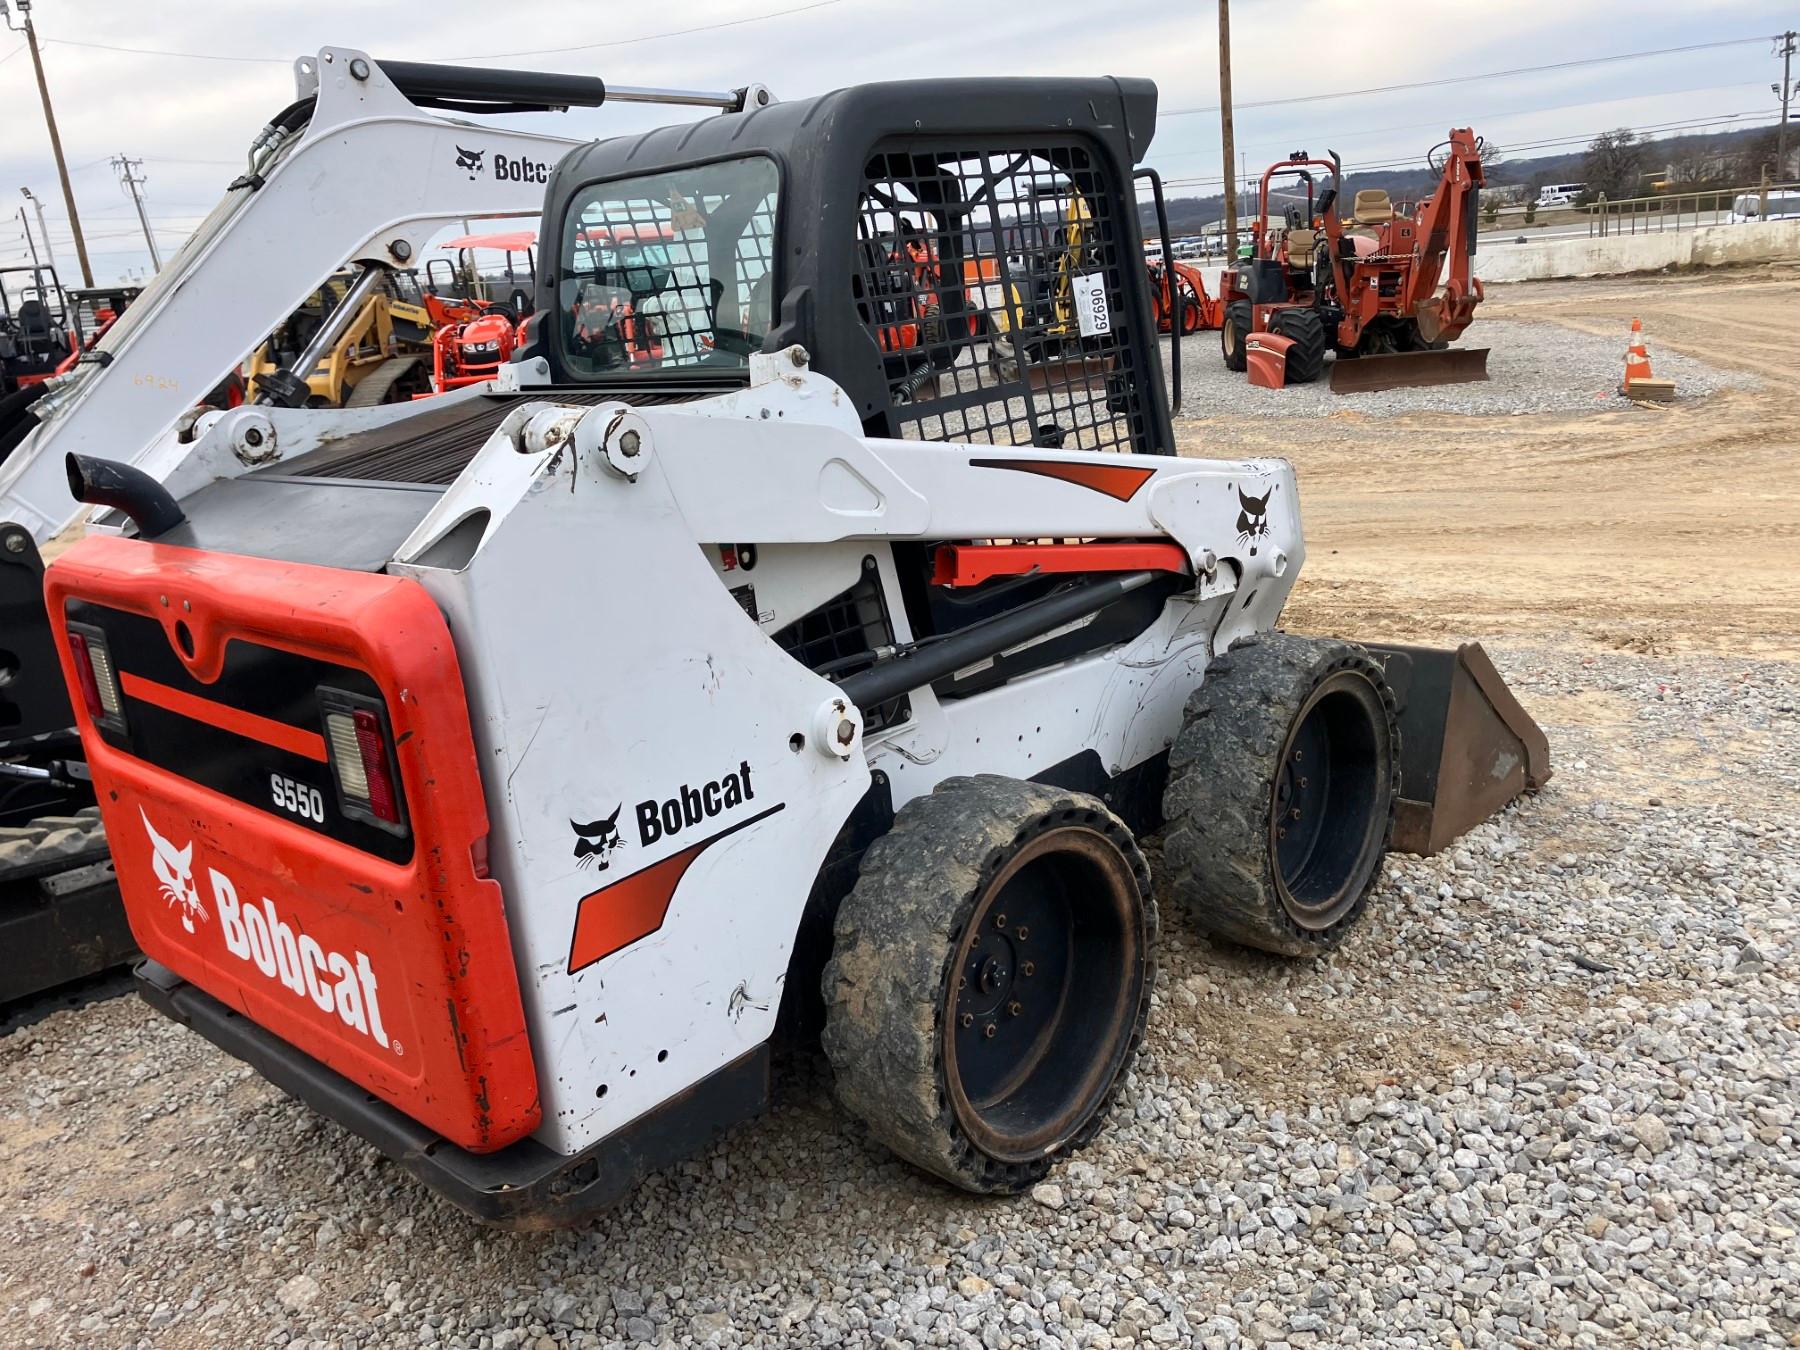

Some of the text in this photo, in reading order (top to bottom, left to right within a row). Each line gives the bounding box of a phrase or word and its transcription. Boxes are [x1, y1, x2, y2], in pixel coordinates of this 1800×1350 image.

[1090, 288, 1108, 331] 06929
[270, 773, 324, 823] S550
[635, 760, 755, 848] Bobcat
[208, 866, 390, 1049] Bobcat
